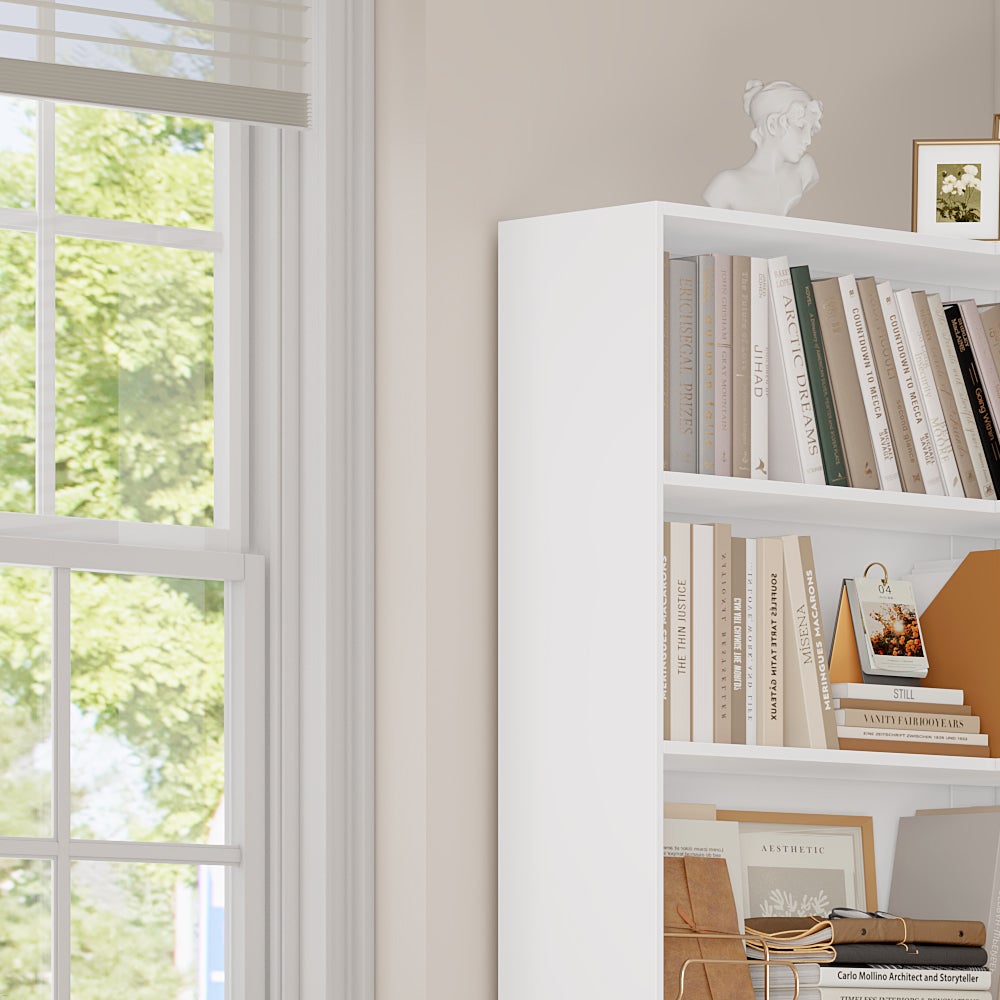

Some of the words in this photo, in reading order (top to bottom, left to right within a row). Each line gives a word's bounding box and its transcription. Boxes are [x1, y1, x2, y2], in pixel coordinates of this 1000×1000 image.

[852, 308, 870, 369] COUNTDOWN
[889, 315, 909, 375] COUNTDOWN
[754, 345, 764, 398] JIHAD
[783, 296, 803, 369] ARCTIC
[796, 374, 818, 456] DREAMS
[865, 371, 875, 384] TO
[905, 376, 915, 389] TO
[680, 382, 693, 435] PRIZES
[869, 386, 882, 420] MECCA
[909, 392, 923, 425] MECCA
[975, 387, 986, 414] Going
[983, 415, 995, 440] Within
[879, 432, 889, 461] SAVAGE
[884, 428, 893, 460] MICHAEL
[920, 436, 932, 465] SAVAGE
[924, 433, 935, 465] MICHAEL
[678, 579, 686, 622] JUSTICE
[806, 569, 822, 636] MACARONS
[878, 585, 892, 595] 04
[678, 626, 686, 650] THIN
[678, 655, 686, 675] THE
[816, 641, 832, 711] MERINGUES
[894, 688, 915, 700] STILL
[762, 844, 825, 855] AESTHETIC
[837, 971, 858, 981] Carlo
[859, 971, 888, 982] Mollino
[889, 972, 922, 982] Architect
[924, 972, 938, 982] and
[939, 973, 979, 984] Storyteller
